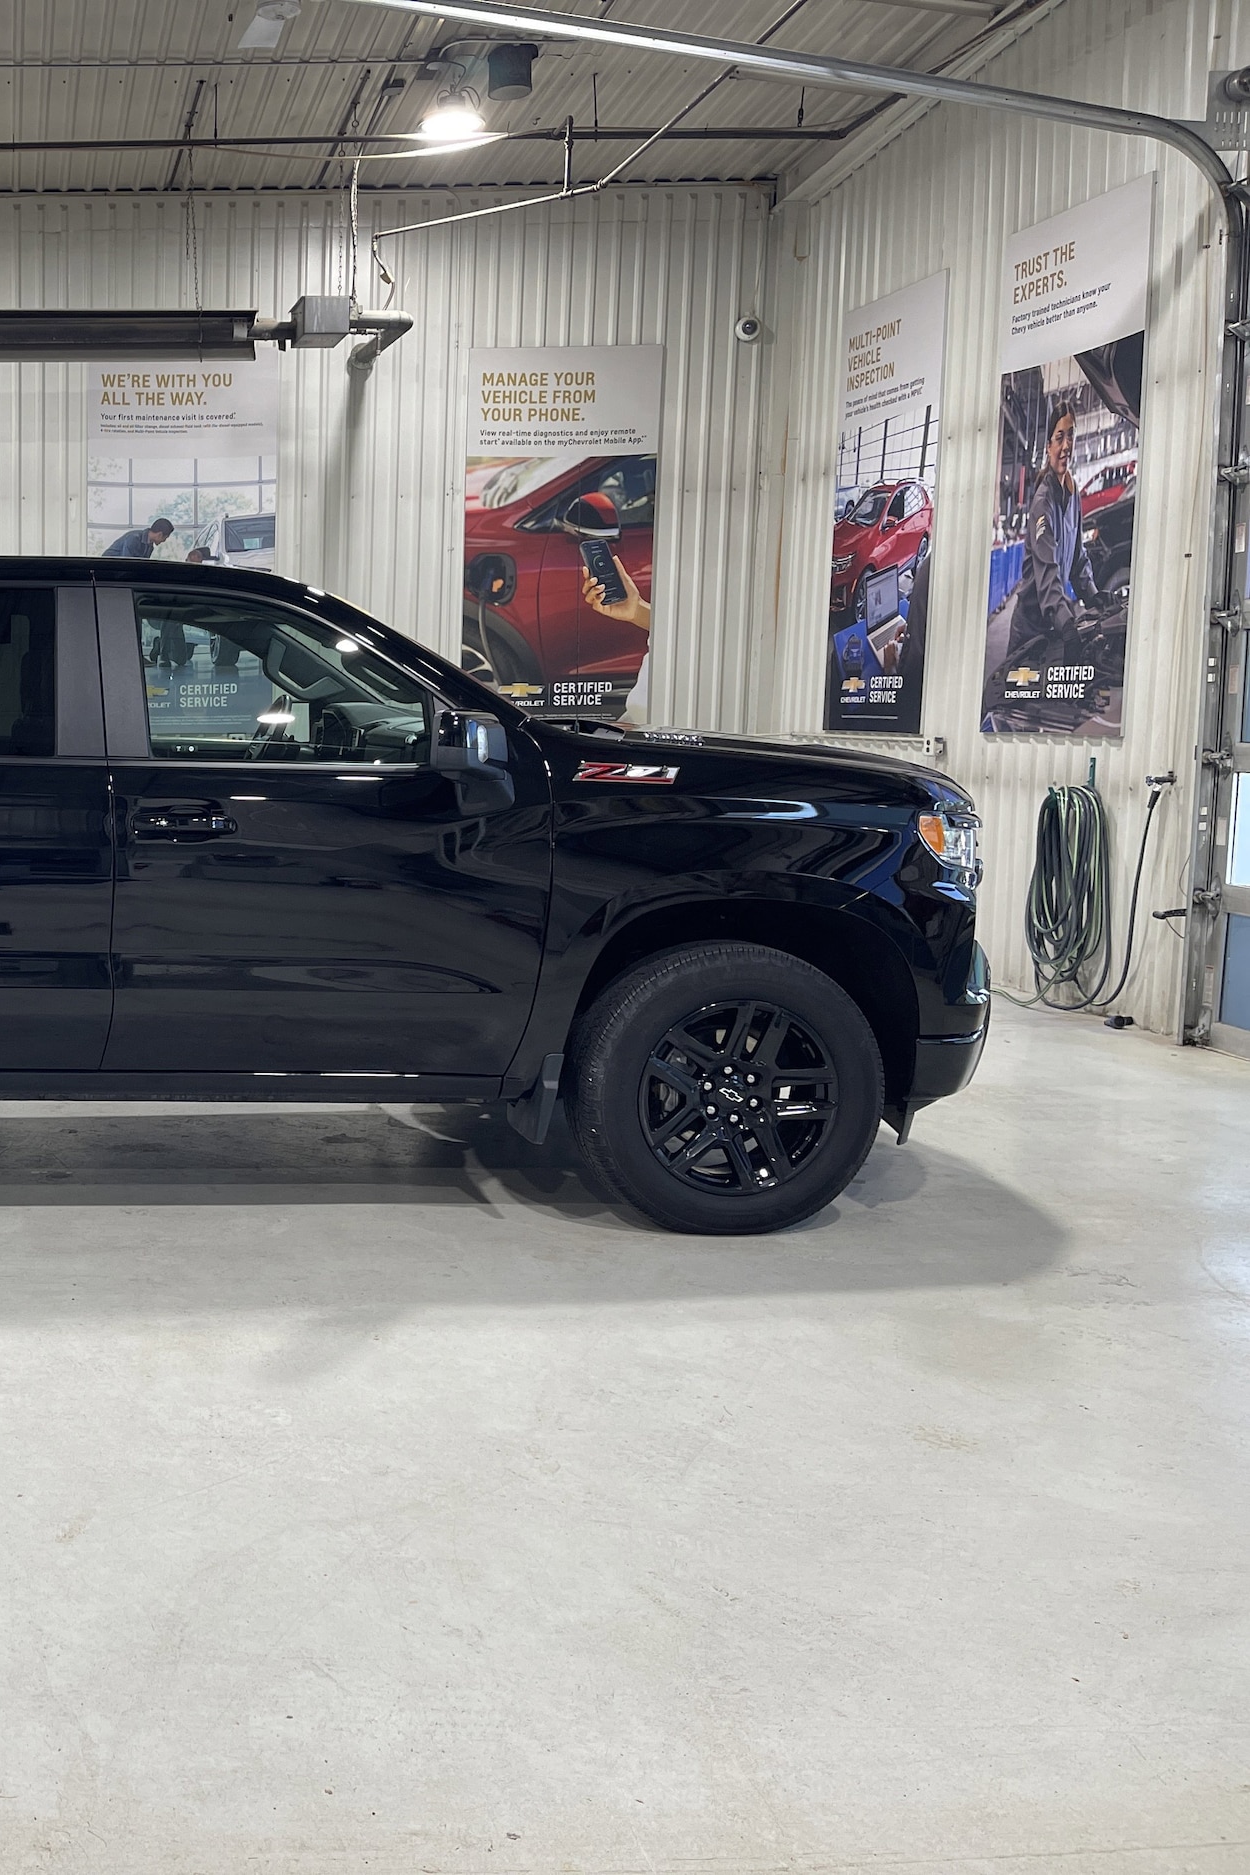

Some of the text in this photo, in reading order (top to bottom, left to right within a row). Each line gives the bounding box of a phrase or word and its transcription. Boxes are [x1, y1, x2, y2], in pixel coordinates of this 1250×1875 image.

[1015, 241, 1075, 281] TRUST THE
[1013, 270, 1067, 304] EXPERTS.
[1012, 283, 1111, 323] Factory trained technicians know your
[1012, 301, 1097, 335] Chevy vehicle better than anyone.
[849, 319, 901, 352] MULTI-POINT
[848, 347, 881, 372] VEHICLE
[101, 373, 232, 388] WE'RE WITH YOU
[482, 372, 594, 386] MANAGE YOUR
[847, 362, 894, 392] INSPECTION
[101, 392, 206, 405] ALL THE WAY.
[482, 390, 596, 404] VEHICLE FROM
[481, 408, 585, 421] YOUR PHONE.
[558, 438, 602, 446] myChevrolet
[1048, 666, 1094, 681] CERTIFIED
[553, 682, 612, 693] CERTIFIED
[870, 676, 903, 688] CERTIFIED
[180, 684, 237, 695] CERTIFIED
[1046, 684, 1085, 698] SERVICE
[180, 697, 227, 707] SERVICE
[553, 695, 601, 706] SERVICE
[870, 691, 896, 703] SERVICE
[572, 761, 681, 784] Z71
